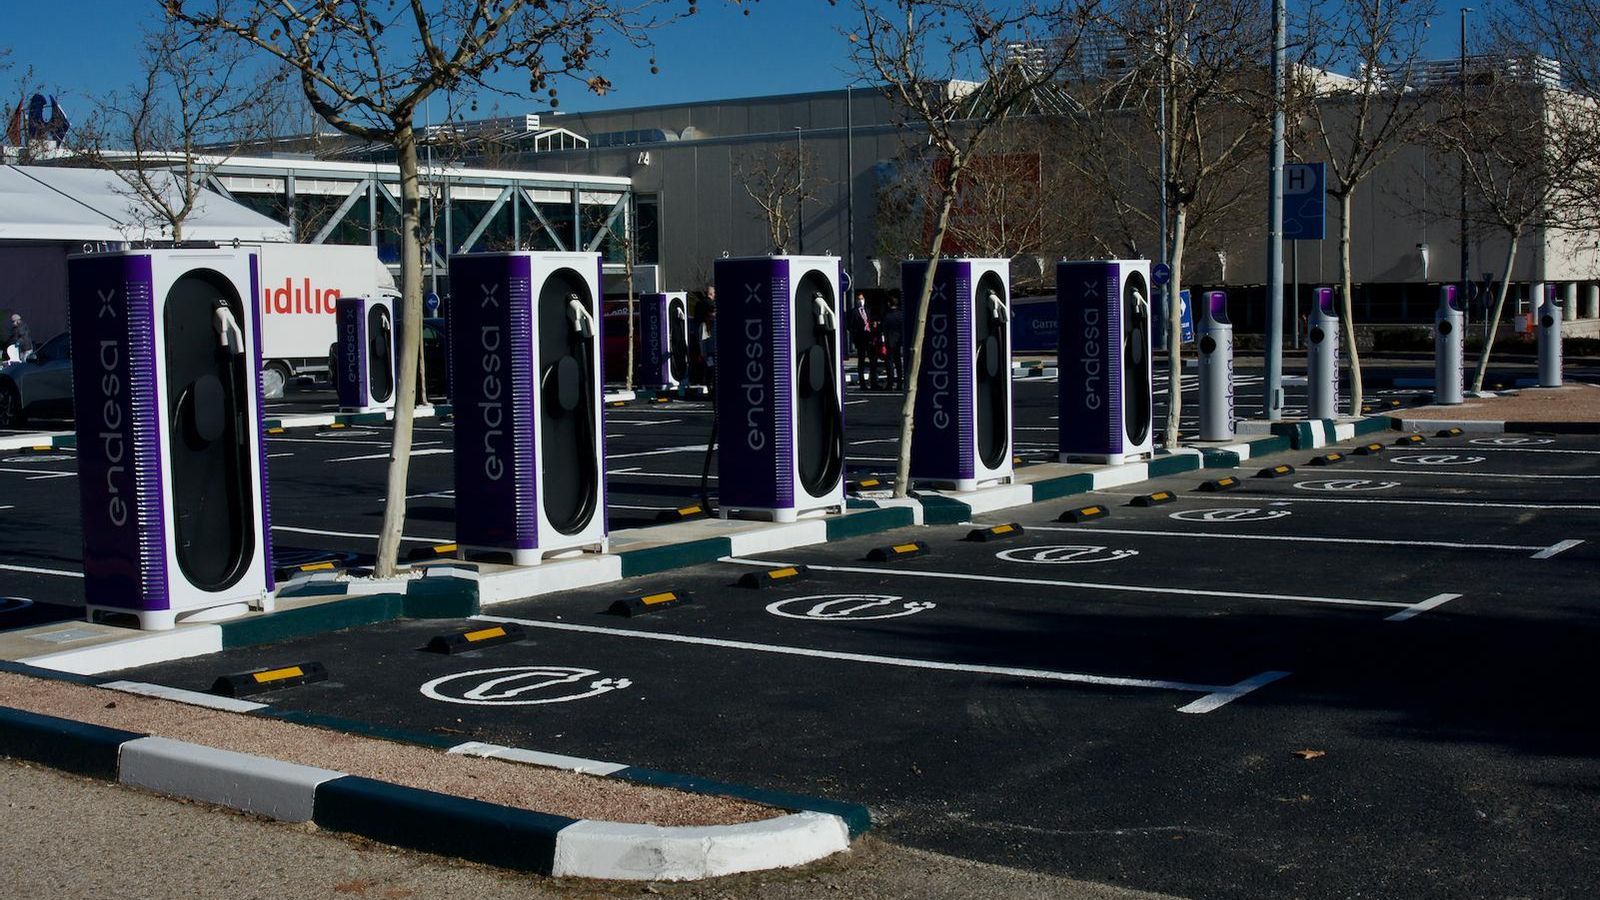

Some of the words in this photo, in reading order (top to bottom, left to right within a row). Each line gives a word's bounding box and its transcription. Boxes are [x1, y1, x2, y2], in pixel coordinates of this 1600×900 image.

[1289, 169, 1305, 189] H
[346, 323, 356, 383] endesa
[927, 313, 950, 430] endesa
[1031, 319, 1059, 329] Carre
[1080, 307, 1101, 410] endesa
[98, 339, 128, 527] endesa
[477, 325, 504, 481] endesa
[740, 318, 765, 450] endesa
